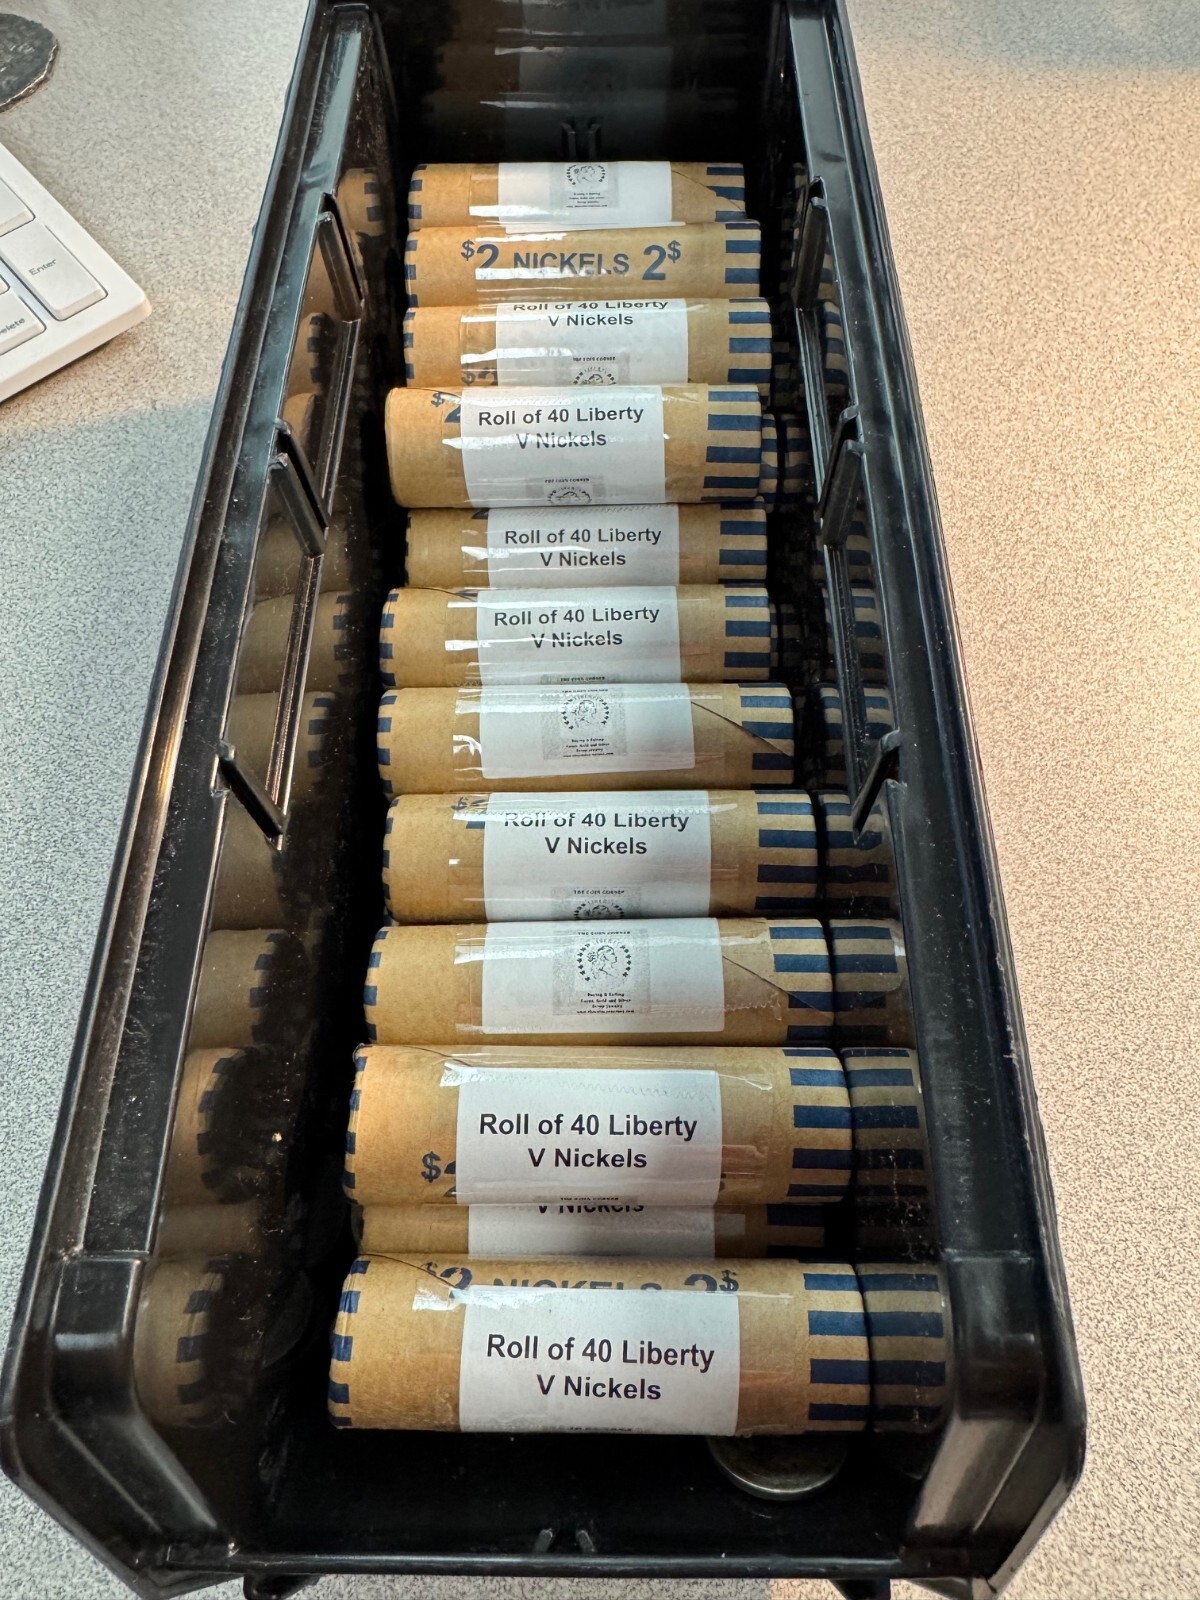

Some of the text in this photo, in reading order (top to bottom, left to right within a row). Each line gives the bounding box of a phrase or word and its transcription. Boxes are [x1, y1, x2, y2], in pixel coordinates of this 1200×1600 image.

[28, 259, 57, 276] Enter
[514, 253, 629, 275] NICKELS
[513, 303, 548, 311] Roll
[554, 302, 573, 310] of
[605, 301, 668, 310] Liberty
[0, 318, 26, 336] elete
[548, 314, 633, 327] V Nickels
[479, 407, 643, 426] Roll of 40 Liberty
[516, 431, 606, 450] V Nickels
[506, 528, 661, 545] Roll of 40 Liberty
[540, 551, 626, 566] V Nickels
[495, 607, 659, 626] Roll of 40 Liberty
[531, 630, 622, 648] V Nickels
[505, 813, 689, 832] Roll of 40 Liberty
[545, 837, 647, 854] V Nickels
[480, 1114, 697, 1143] Roll of 40 Liberty
[528, 1148, 647, 1168] V Nickels
[488, 1334, 714, 1373] Roll of 40 Liberty
[537, 1375, 661, 1400] V Nickels
